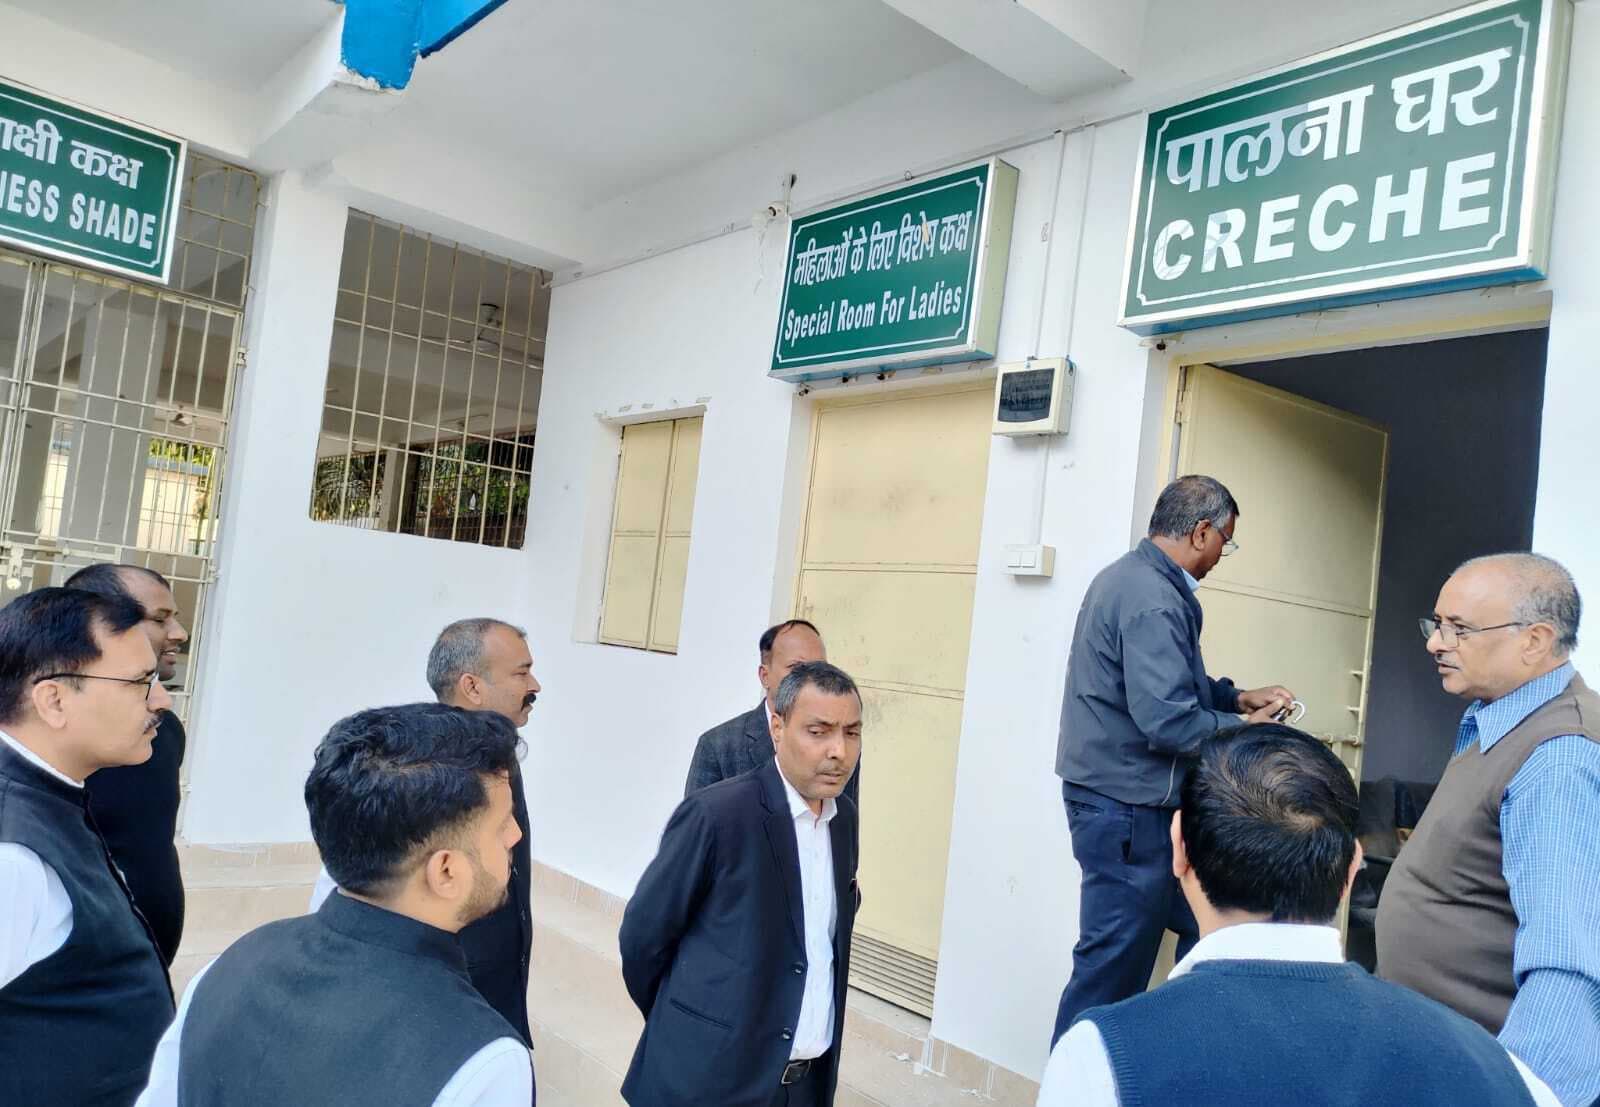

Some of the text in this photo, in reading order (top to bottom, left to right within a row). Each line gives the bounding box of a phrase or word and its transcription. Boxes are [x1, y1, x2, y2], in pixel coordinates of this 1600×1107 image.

[0, 116, 144, 190] ाक्षी कक्ष
[1165, 46, 1513, 193] पालना घर
[69, 192, 156, 250] SHADE
[794, 210, 973, 286] महिलाओं के लिए विशेष कक्ष
[1152, 151, 1496, 281] CRECHE
[784, 281, 962, 348] Special Room For Ladies
